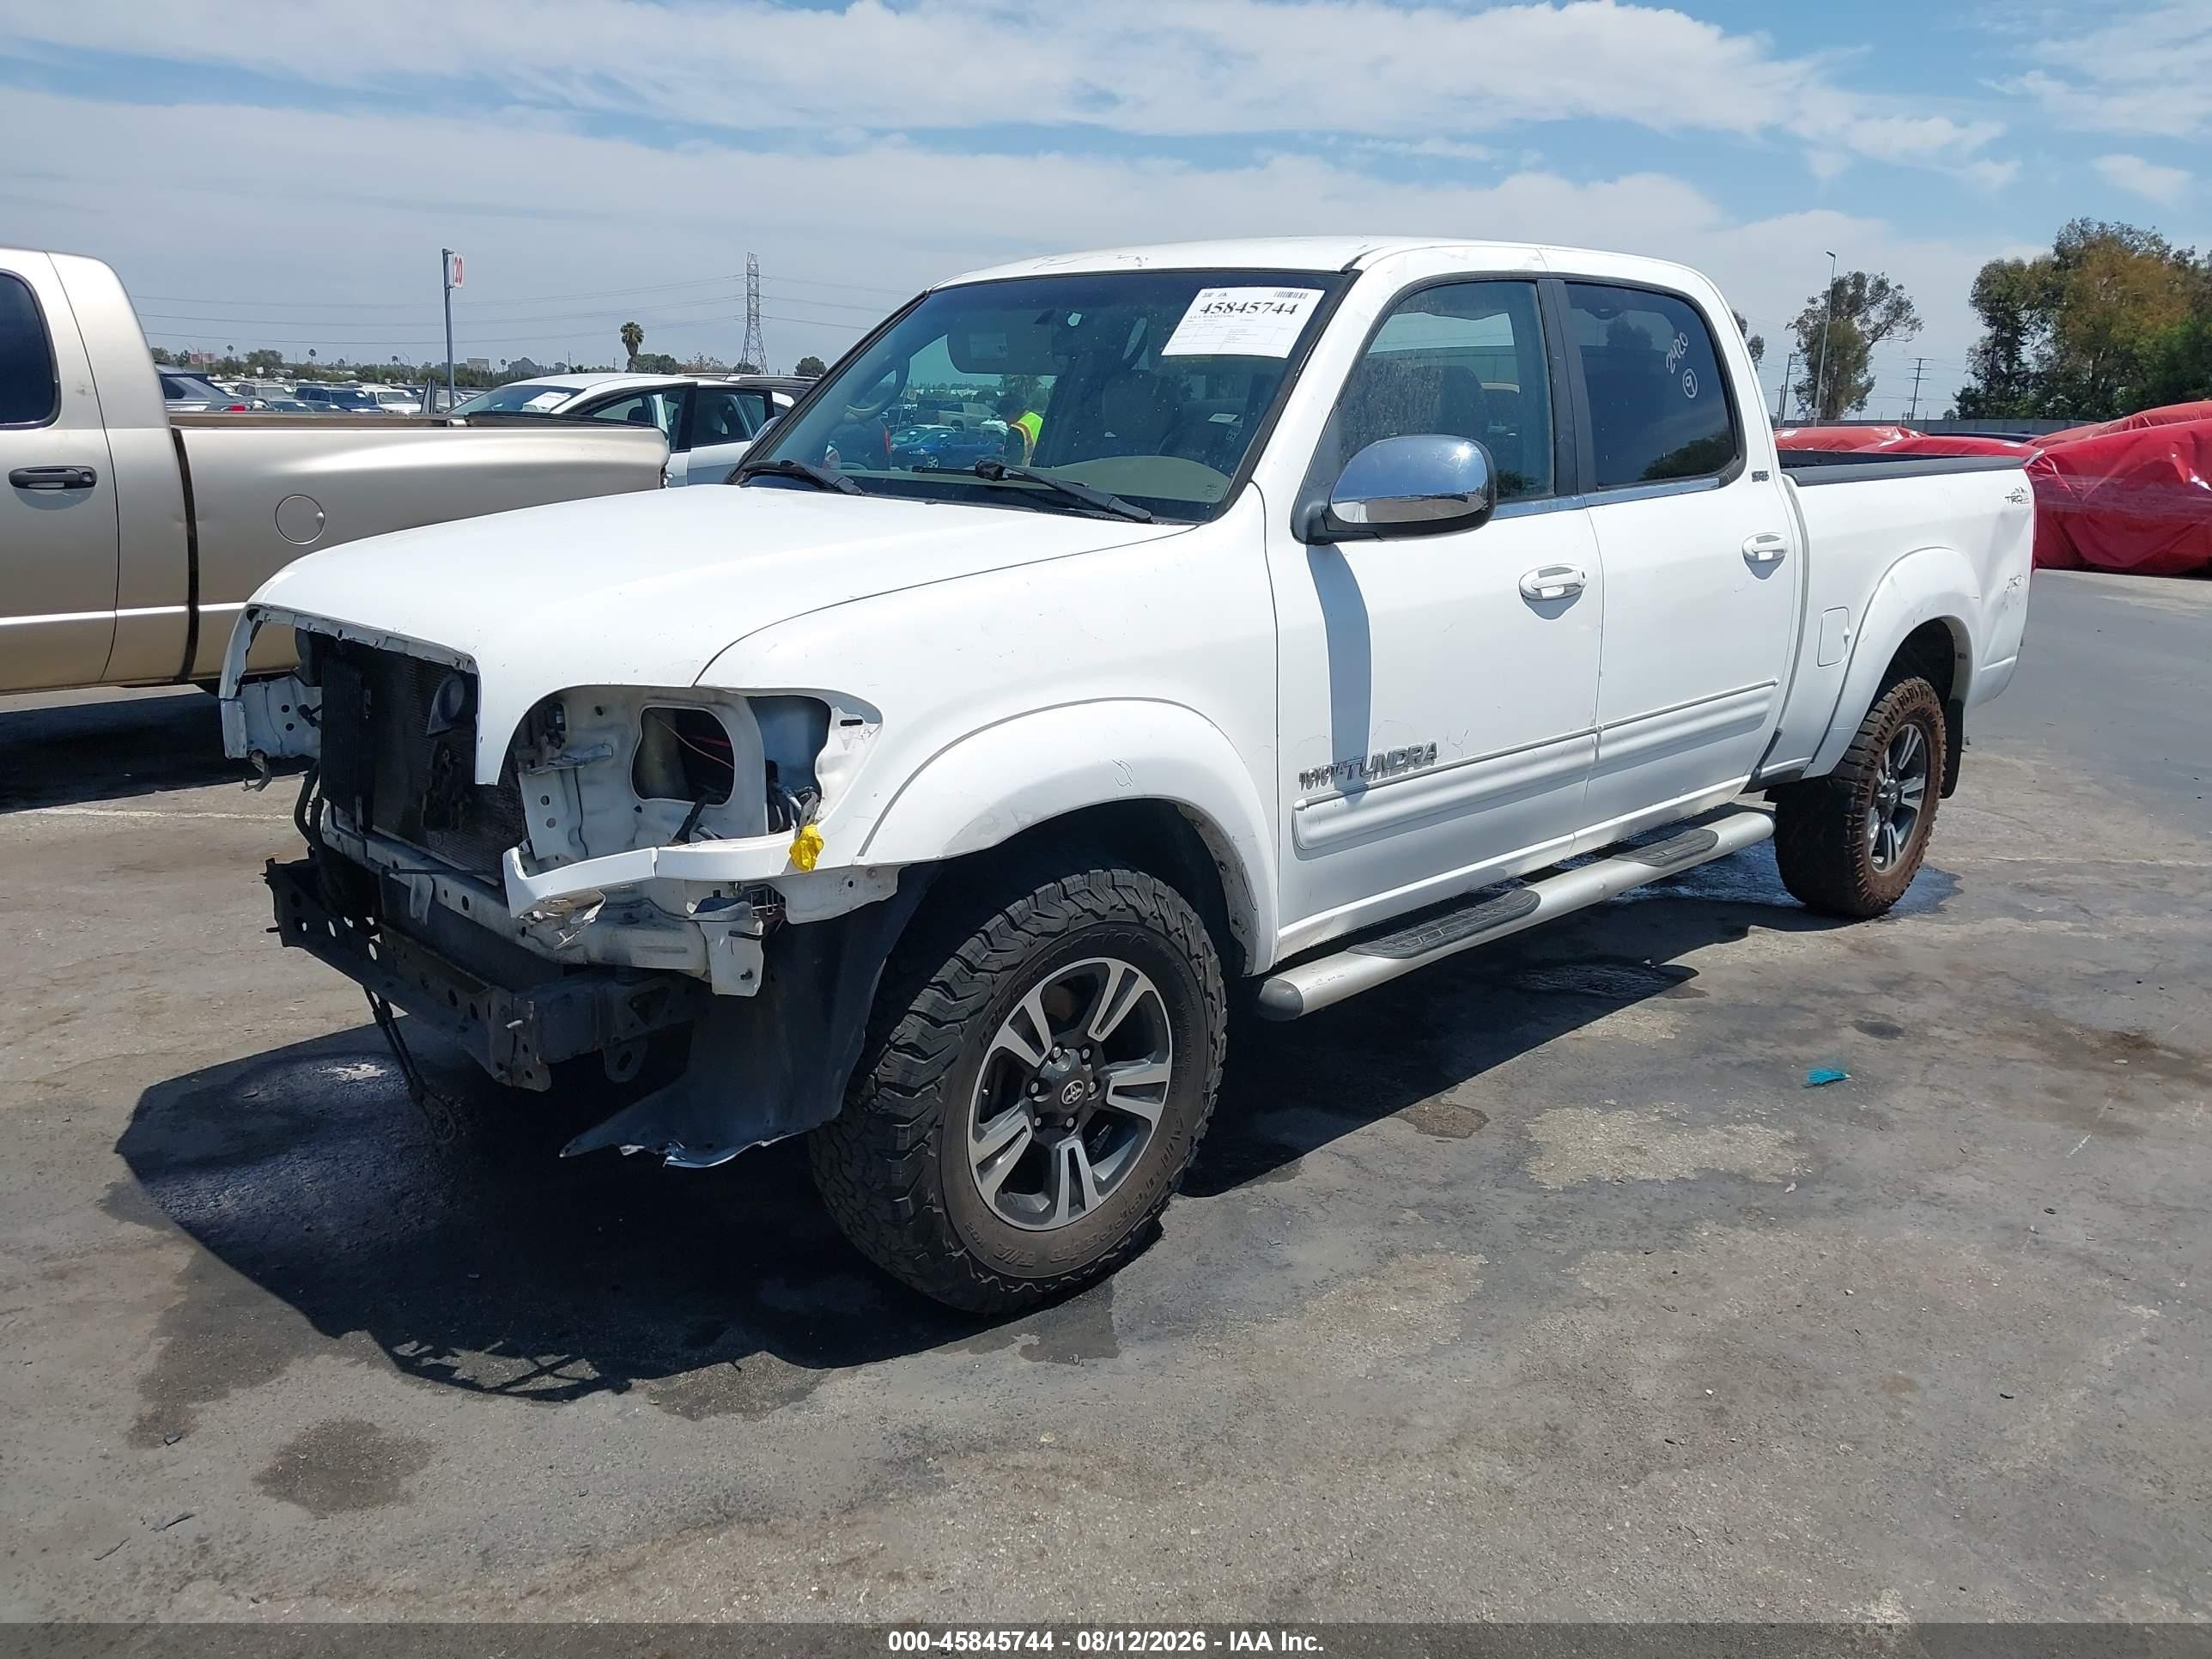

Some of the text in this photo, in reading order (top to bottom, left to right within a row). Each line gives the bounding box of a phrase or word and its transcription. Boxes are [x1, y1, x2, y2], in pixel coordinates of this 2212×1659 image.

[454, 256, 463, 284] 20
[1200, 301, 1298, 315] 45845744
[1666, 331, 1689, 374] 2420
[2005, 495, 2023, 505] TRD
[1346, 742, 1437, 781] TUNDRA
